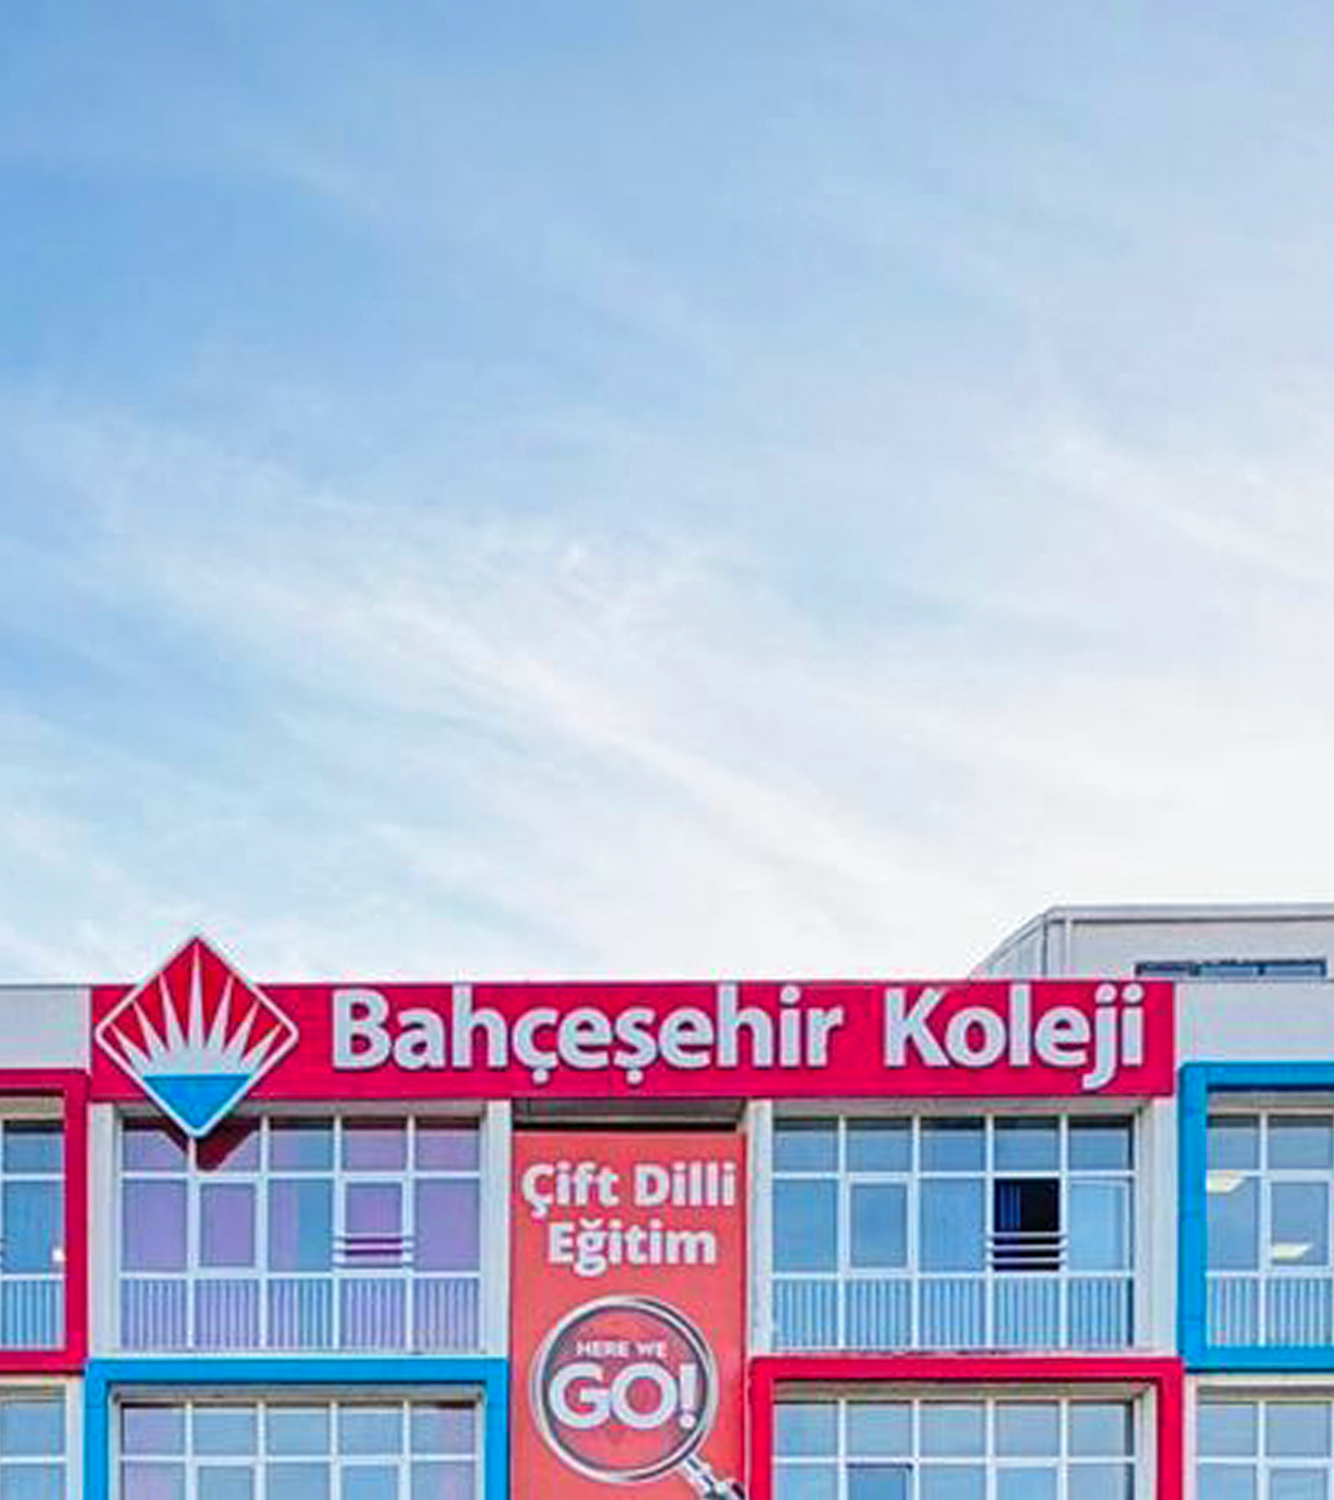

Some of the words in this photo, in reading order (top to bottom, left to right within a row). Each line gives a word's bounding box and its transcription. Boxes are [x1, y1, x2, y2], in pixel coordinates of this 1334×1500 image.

[331, 983, 845, 1085] Bahçeşehir
[883, 982, 1145, 1090] Koleji
[522, 1161, 619, 1218] Çift
[634, 1161, 737, 1207] Dilli
[548, 1219, 717, 1277] Eğitim
[576, 1340, 630, 1357] HERE
[635, 1340, 668, 1357] WE
[549, 1361, 697, 1430] GO!
